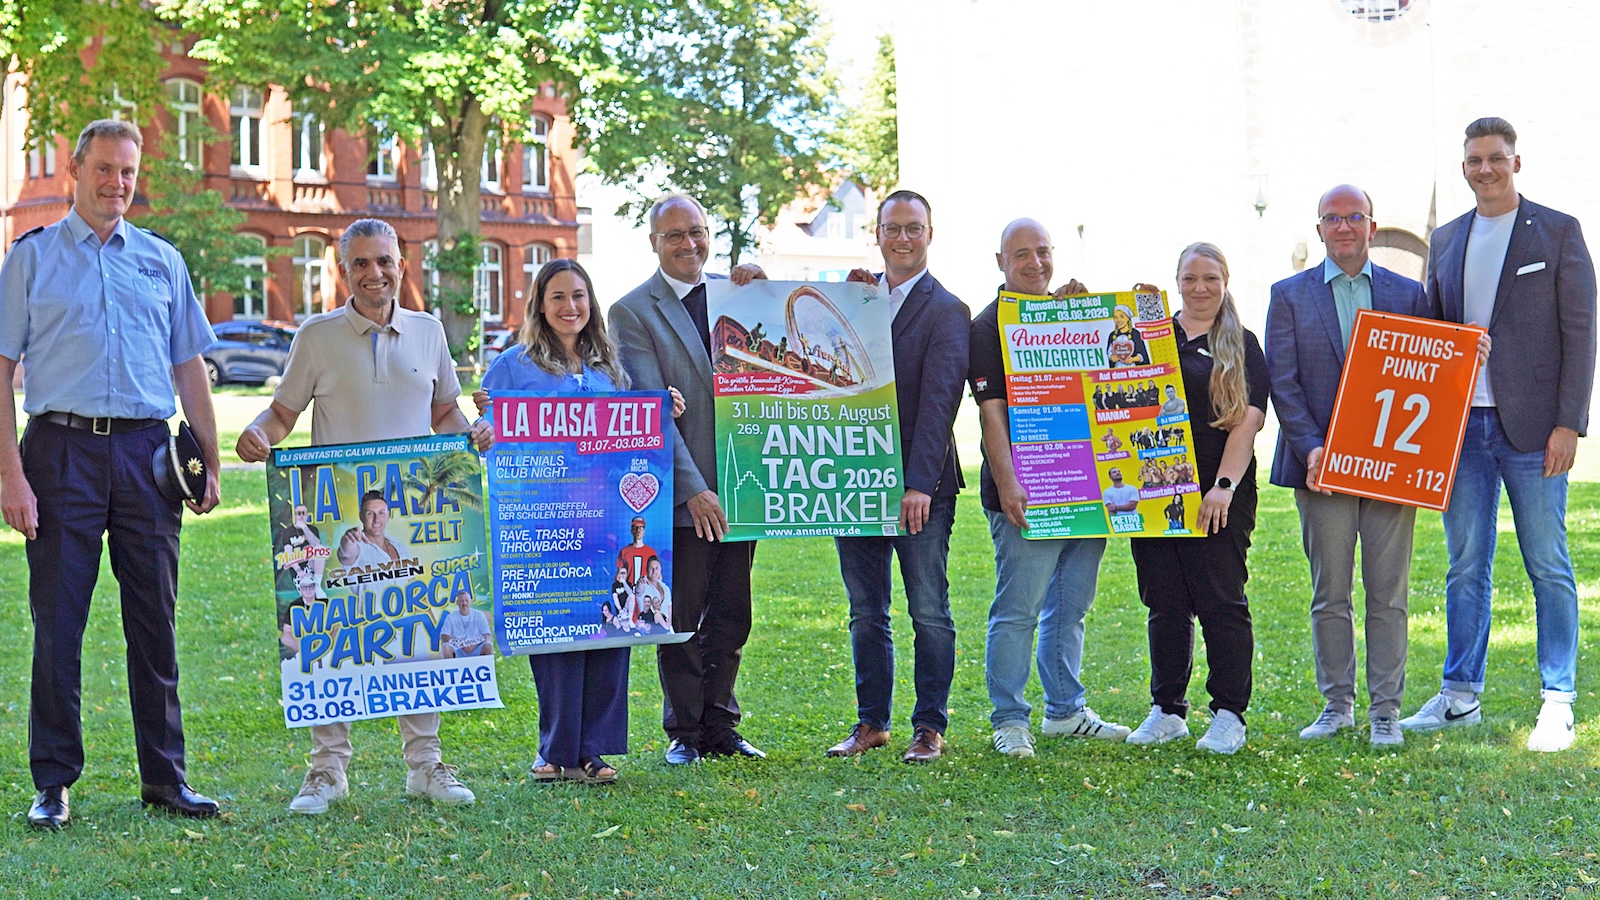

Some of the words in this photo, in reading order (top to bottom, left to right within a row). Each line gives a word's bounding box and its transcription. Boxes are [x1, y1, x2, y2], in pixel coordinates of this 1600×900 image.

[138, 268, 161, 278] POLIZEI
[1025, 299, 1068, 311] Annentag
[1070, 296, 1101, 306] Brakel
[1021, 311, 1051, 322] 31.07.
[1057, 307, 1109, 321] 03.08.2026
[1011, 327, 1100, 347] Annekens
[1367, 328, 1463, 360] RETTUNGS-
[1014, 348, 1105, 368] TANZGARTEN
[1099, 372, 1111, 380] Auf
[1112, 371, 1127, 379] dem
[1128, 366, 1165, 378] Kirchplatz
[1382, 356, 1440, 383] PUNKT
[718, 376, 729, 385] Die
[1009, 375, 1033, 383] Freitag
[1034, 374, 1054, 382] 31.07.
[719, 385, 744, 393] zwischen
[778, 384, 796, 394] Egge!
[732, 402, 755, 418] 31.
[759, 401, 783, 419] Juli
[787, 401, 808, 420] bis
[812, 404, 834, 420] 03.
[838, 404, 891, 425] August
[1013, 407, 1041, 415] Samstag
[1042, 406, 1063, 414] 01.08.
[1096, 410, 1130, 422] MANIAC
[502, 402, 530, 437] LA
[539, 402, 598, 437] CASA
[607, 402, 656, 437] ZELT
[1160, 416, 1168, 424] DJ
[1373, 388, 1431, 455] 12
[737, 424, 763, 435] 269.
[579, 436, 661, 452] 31.07.-03.08.26
[761, 424, 894, 456] ANNEN
[280, 454, 291, 462] DJ
[442, 441, 465, 451] BROS
[1016, 444, 1043, 452] Sonntag
[495, 455, 565, 467] MILLENIALS
[631, 458, 648, 466] SCAN
[1105, 452, 1127, 460] Glücklich
[496, 467, 528, 479] CLUB
[531, 466, 569, 478] NIGHT
[762, 458, 837, 489] TAG
[843, 468, 897, 489] 2026
[1328, 452, 1397, 482] NOTRUF
[1041, 475, 1088, 483] Partyschlagerabend
[289, 464, 343, 524] LA
[1140, 487, 1175, 499] Mountain
[1176, 484, 1198, 494] Crew
[498, 502, 588, 511] EHEMALIGENTREFFEN
[765, 492, 898, 523] BRAKEL
[1050, 506, 1072, 514] 03.08.
[498, 511, 515, 520] DER
[516, 511, 556, 520] SCHULEN
[557, 510, 574, 519] DER
[576, 509, 604, 518] BREDE
[1110, 514, 1140, 525] PIETRO
[409, 519, 463, 545] ZELT
[500, 530, 532, 541] RAVE,
[535, 528, 575, 540] TRASH
[576, 527, 585, 539] &
[765, 526, 861, 537] www.annentag.de
[1113, 523, 1142, 533] BASILE
[500, 539, 582, 553] THROWBACKS
[328, 557, 419, 578] CALVIN
[431, 555, 480, 577] SUPER
[501, 566, 592, 580] PRE-MALLORCA
[326, 566, 424, 588] KLEINEN
[502, 580, 540, 592] PARTY
[290, 570, 475, 638] MALLORCA
[504, 616, 543, 628] SUPER
[506, 627, 567, 640] MALLORCA
[568, 624, 602, 635] PARTY
[298, 610, 449, 674] PARTY
[517, 638, 543, 646] CALVIN
[544, 636, 574, 644] KLEINEN
[366, 666, 492, 693] ANNENTAG
[288, 677, 360, 701] 31.07.
[367, 683, 496, 715] BRAKEL
[286, 700, 363, 722] 03.08.
